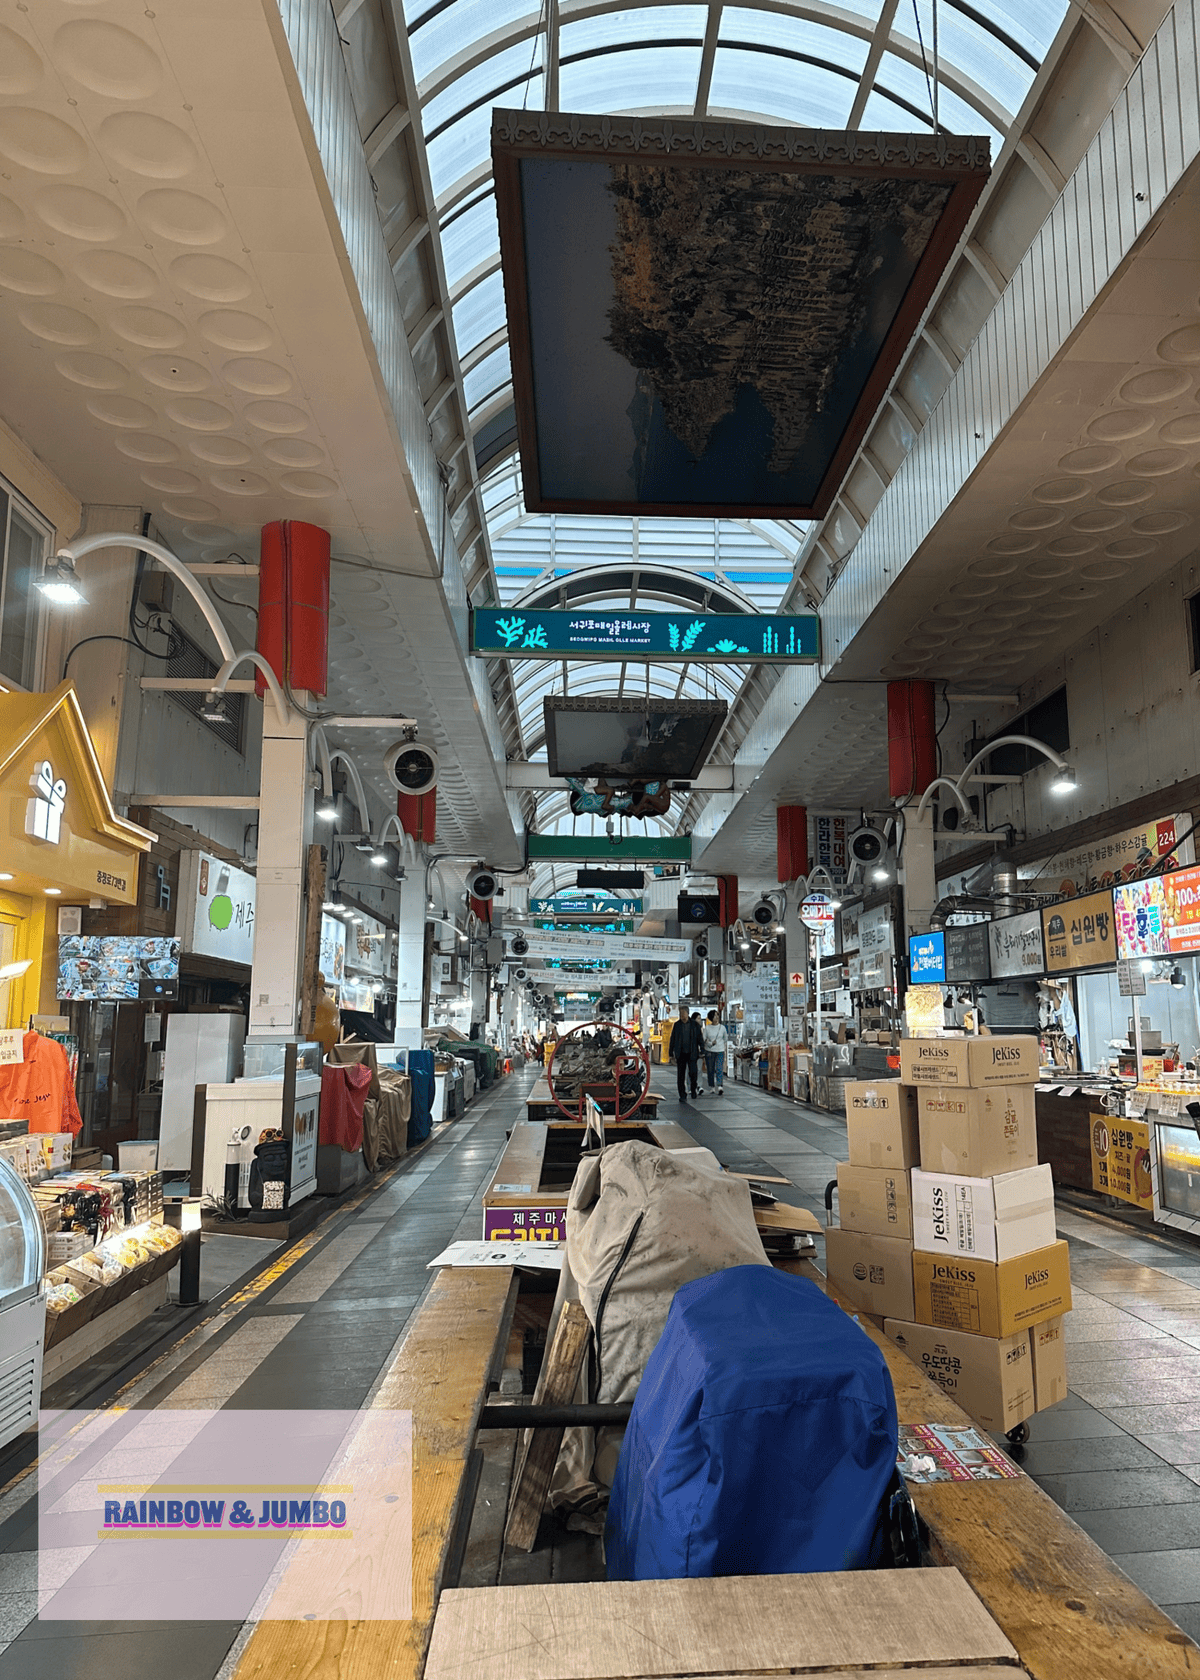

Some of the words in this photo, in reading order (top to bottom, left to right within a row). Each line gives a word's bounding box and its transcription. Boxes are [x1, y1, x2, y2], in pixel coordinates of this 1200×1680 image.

[569, 619, 651, 636] 서귀포매일올레시장
[818, 817, 831, 867] 한라한복
[833, 817, 846, 868] 한복대여
[1158, 830, 1175, 847] 224
[802, 904, 835, 919] 오메기떡
[1070, 912, 1110, 946] 십원빵
[1021, 952, 1042, 968] 9,000원
[1049, 944, 1067, 959] 우리쌀
[919, 1047, 949, 1058] JeKiss
[991, 1046, 1021, 1065] JeKiss
[1111, 1128, 1134, 1150] 십원빵
[1110, 1177, 1131, 1195] 10,000원
[932, 1187, 949, 1244] JeKiss
[932, 1264, 976, 1283] JeKiss
[1024, 1269, 1049, 1290] JeKiss
[921, 1352, 963, 1375] 우도땅콩
